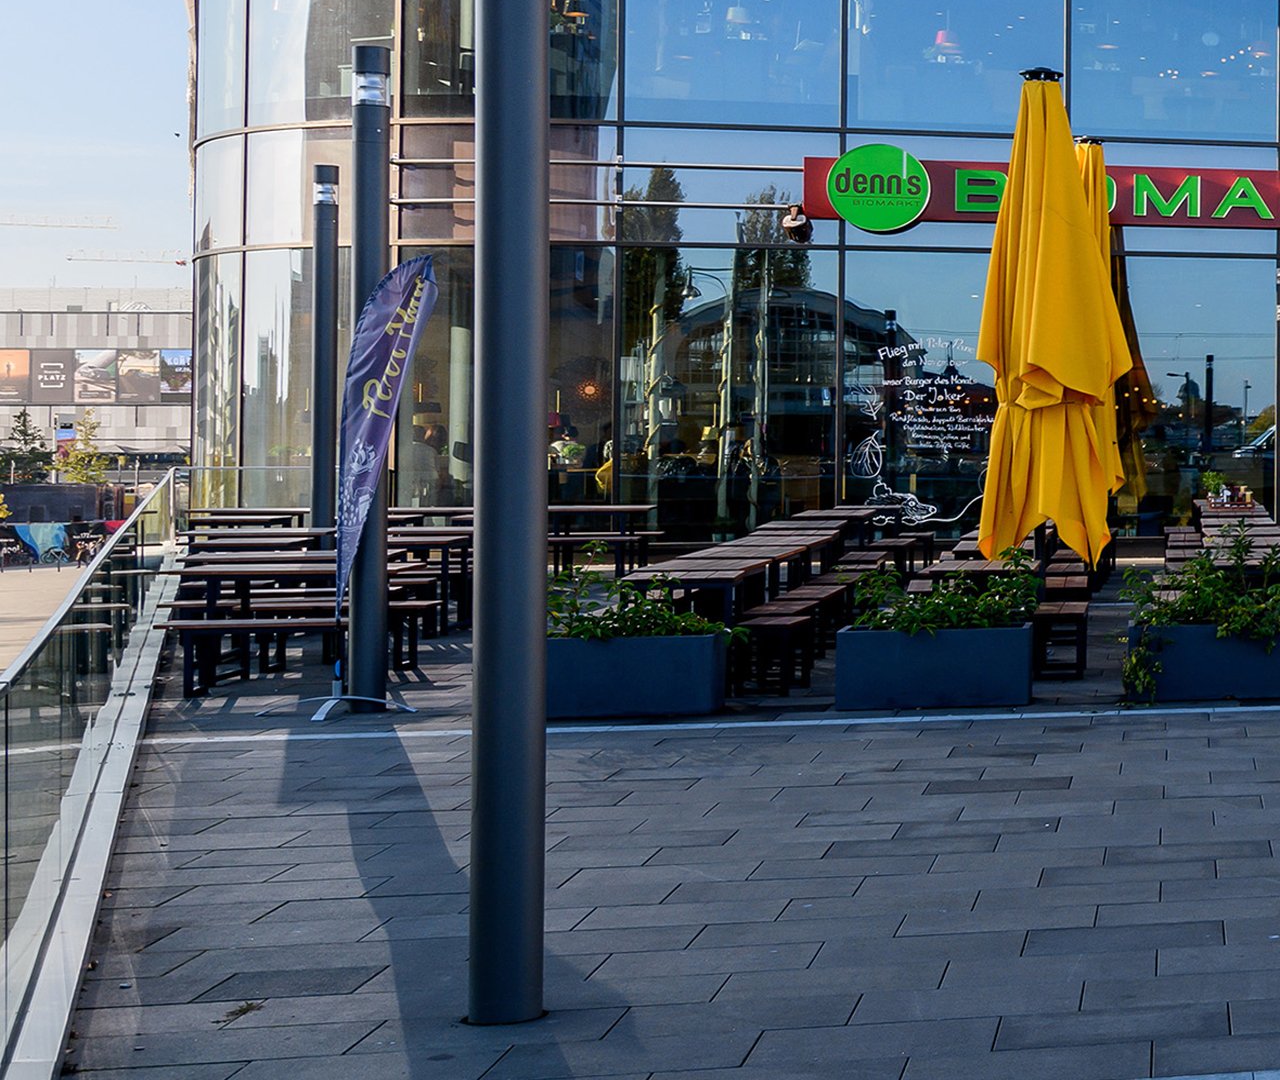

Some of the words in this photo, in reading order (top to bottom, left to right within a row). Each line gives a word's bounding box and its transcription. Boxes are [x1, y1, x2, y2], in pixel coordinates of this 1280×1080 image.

[877, 345, 908, 361] Flieg
[908, 338, 923, 351] mit
[904, 376, 933, 389] Burger
[934, 376, 949, 385] des
[903, 389, 927, 401] Der
[928, 386, 966, 404] Joker
